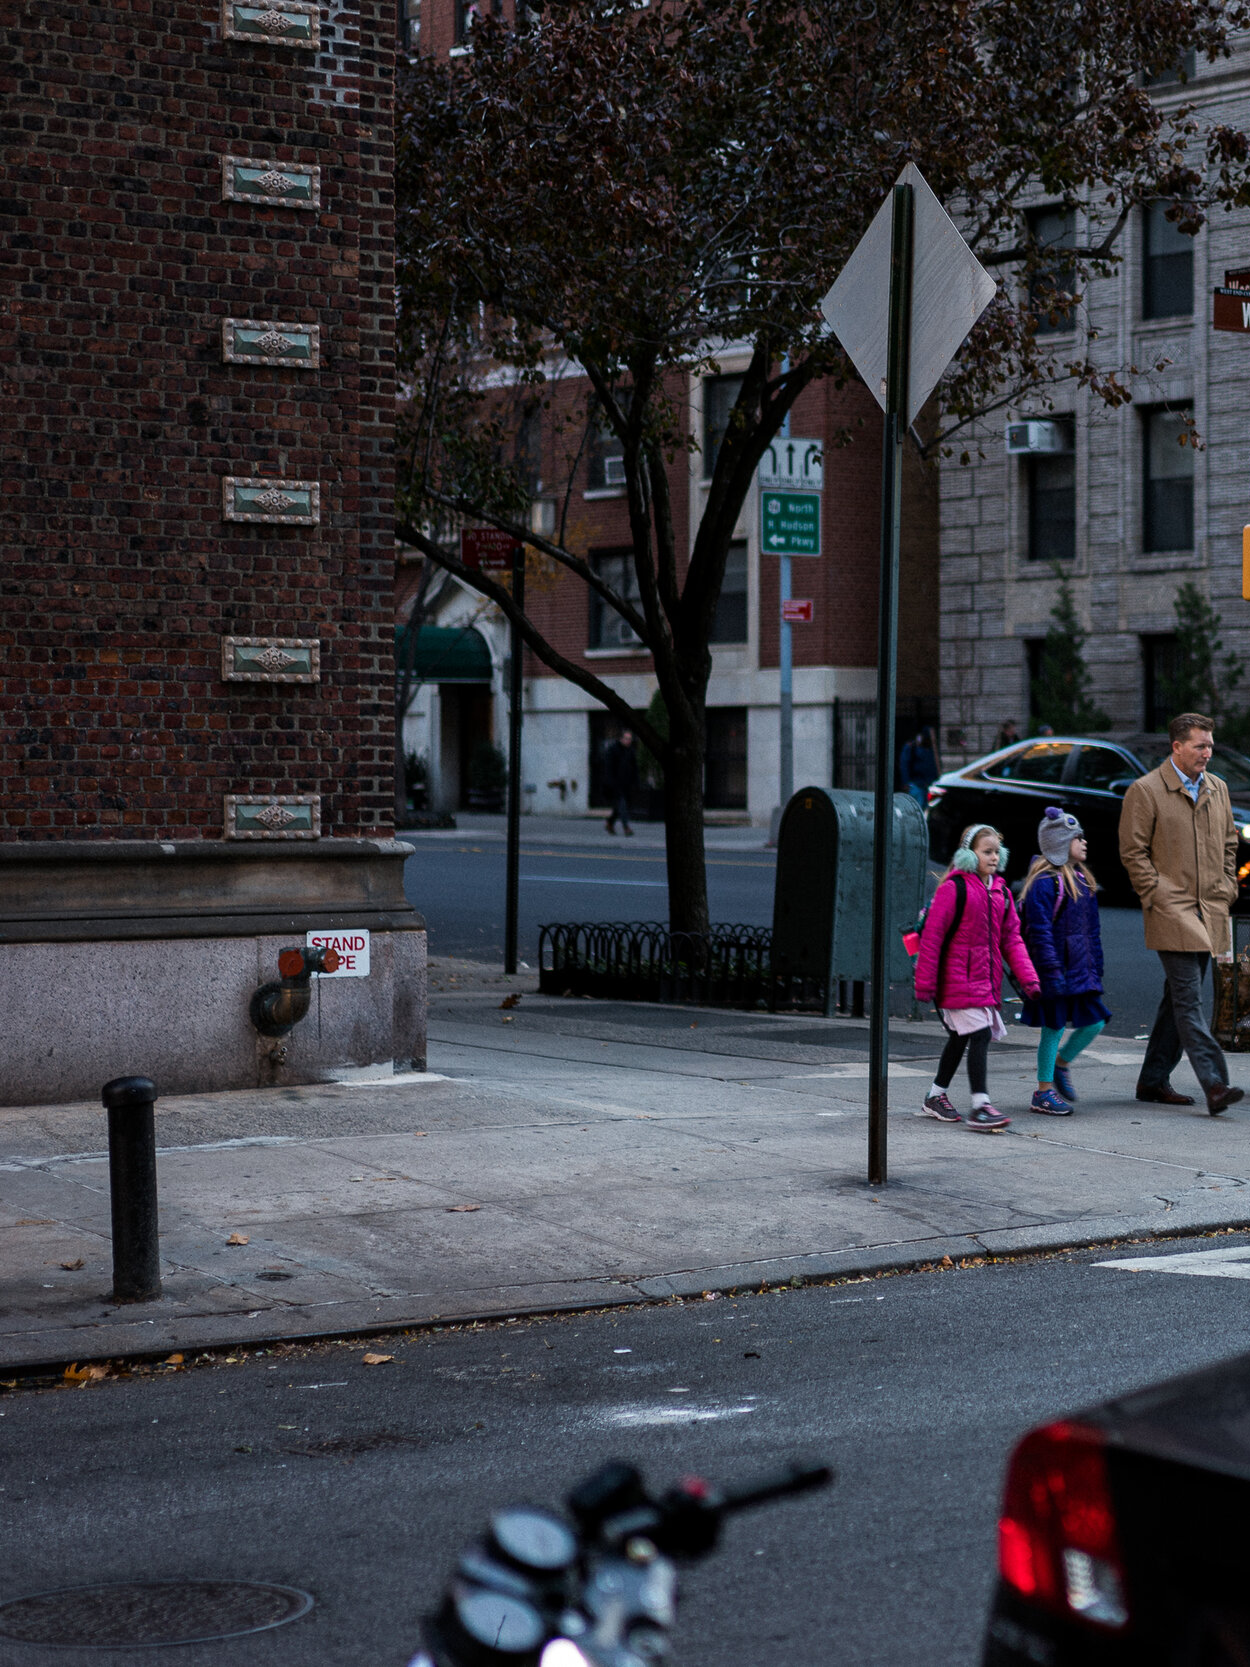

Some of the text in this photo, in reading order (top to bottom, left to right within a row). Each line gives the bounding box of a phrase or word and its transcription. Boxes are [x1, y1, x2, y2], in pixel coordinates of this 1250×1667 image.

[788, 503, 814, 514] North
[781, 520, 814, 532] Hudson
[791, 536, 814, 549] Pkwy
[312, 936, 365, 951] STAND
